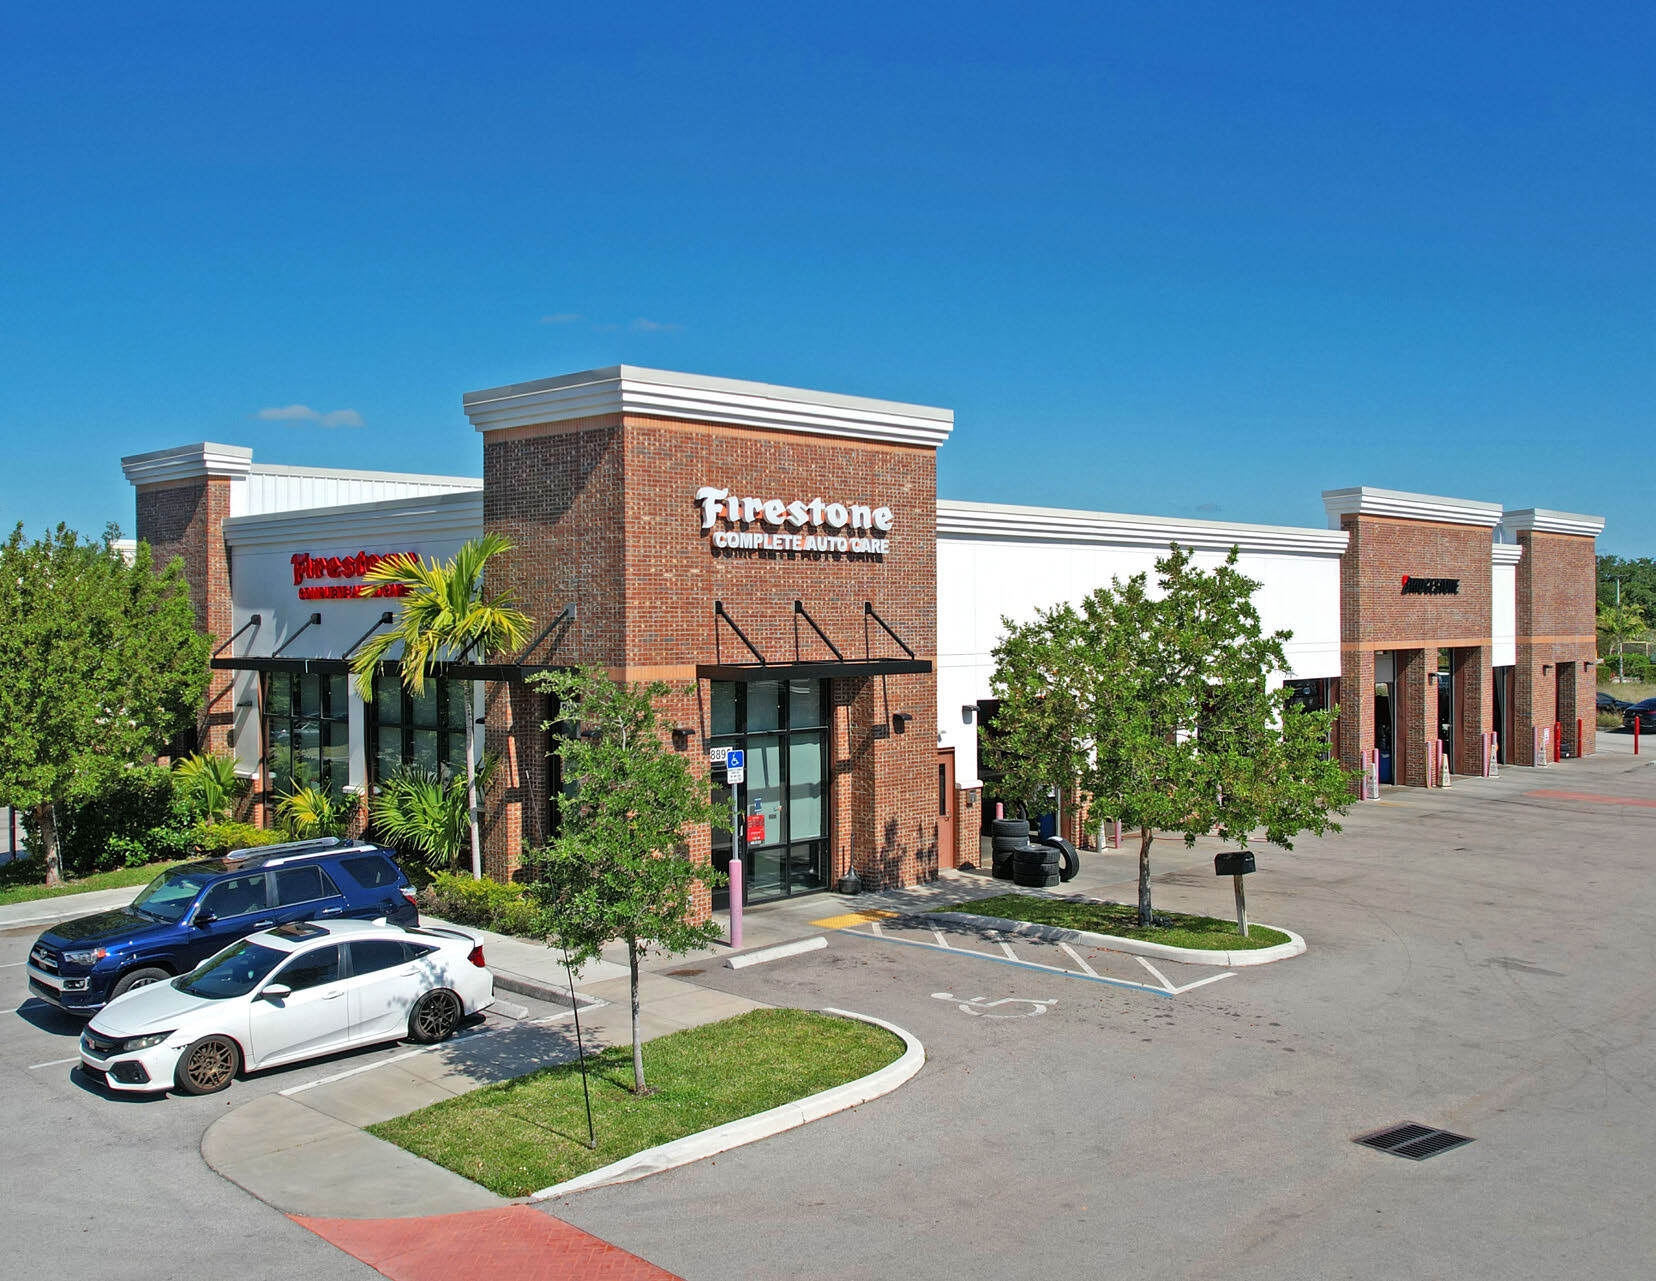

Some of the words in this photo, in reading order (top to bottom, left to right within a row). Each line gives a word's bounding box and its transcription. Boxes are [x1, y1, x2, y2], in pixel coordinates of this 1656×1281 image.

[695, 486, 894, 531] Firestone
[712, 531, 802, 551] COMPLETE
[804, 537, 848, 552] AUTO
[850, 538, 890, 554] CARE
[710, 748, 731, 760] 889
